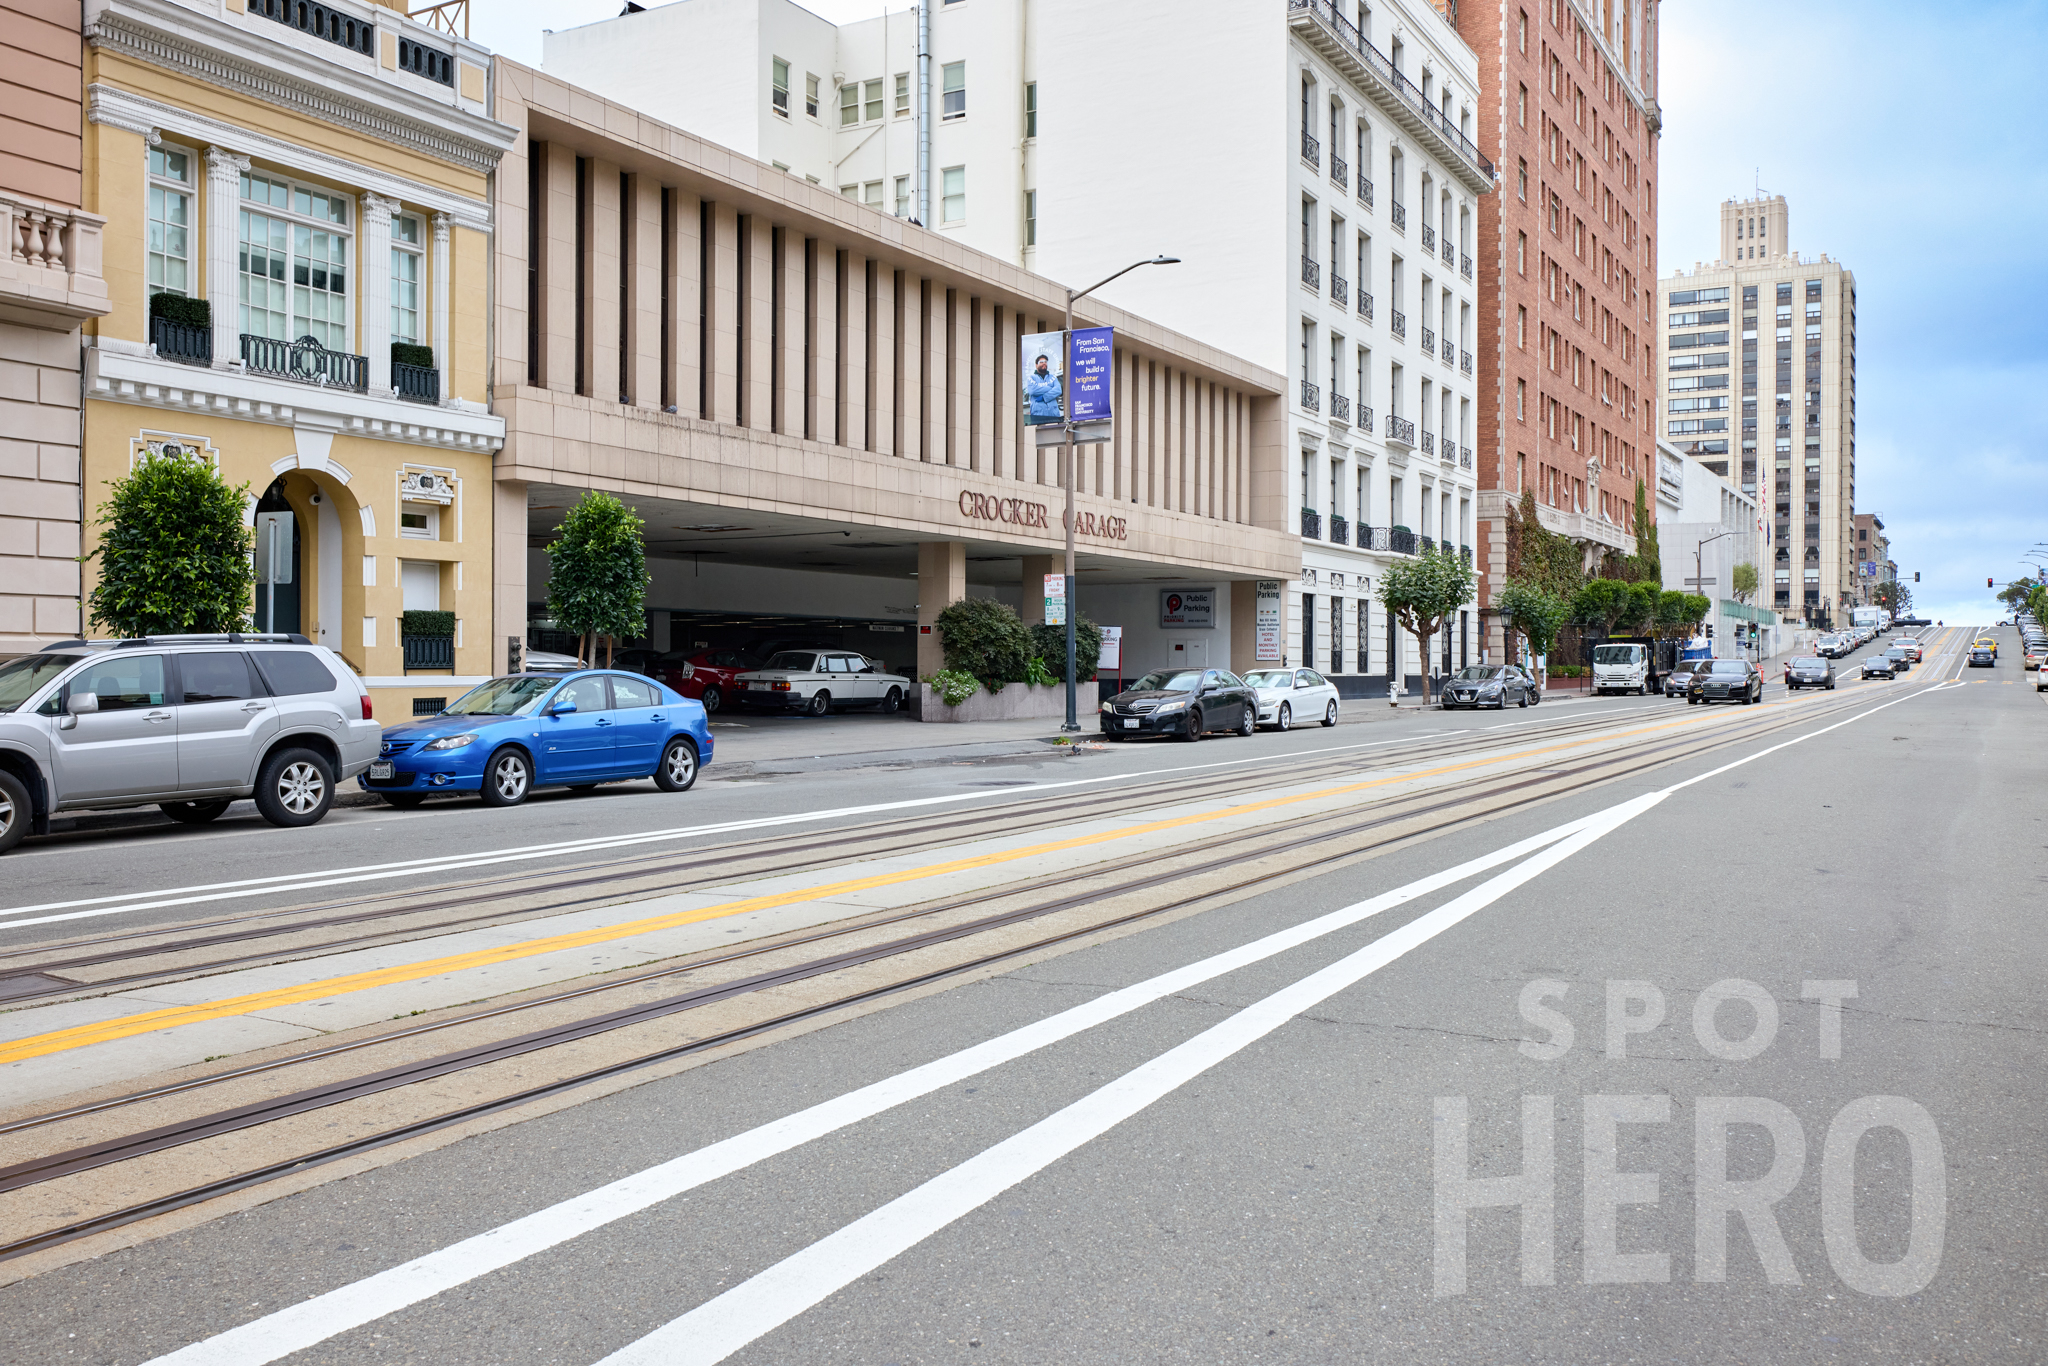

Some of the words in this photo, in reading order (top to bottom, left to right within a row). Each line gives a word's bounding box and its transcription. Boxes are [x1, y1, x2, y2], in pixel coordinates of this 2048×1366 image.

[1080, 345, 1110, 353] Francisco,
[1075, 375, 1098, 384] brighter
[958, 489, 1048, 528] CROCKER
[1258, 591, 1280, 599] Parking
[1184, 605, 1210, 613] Parking
